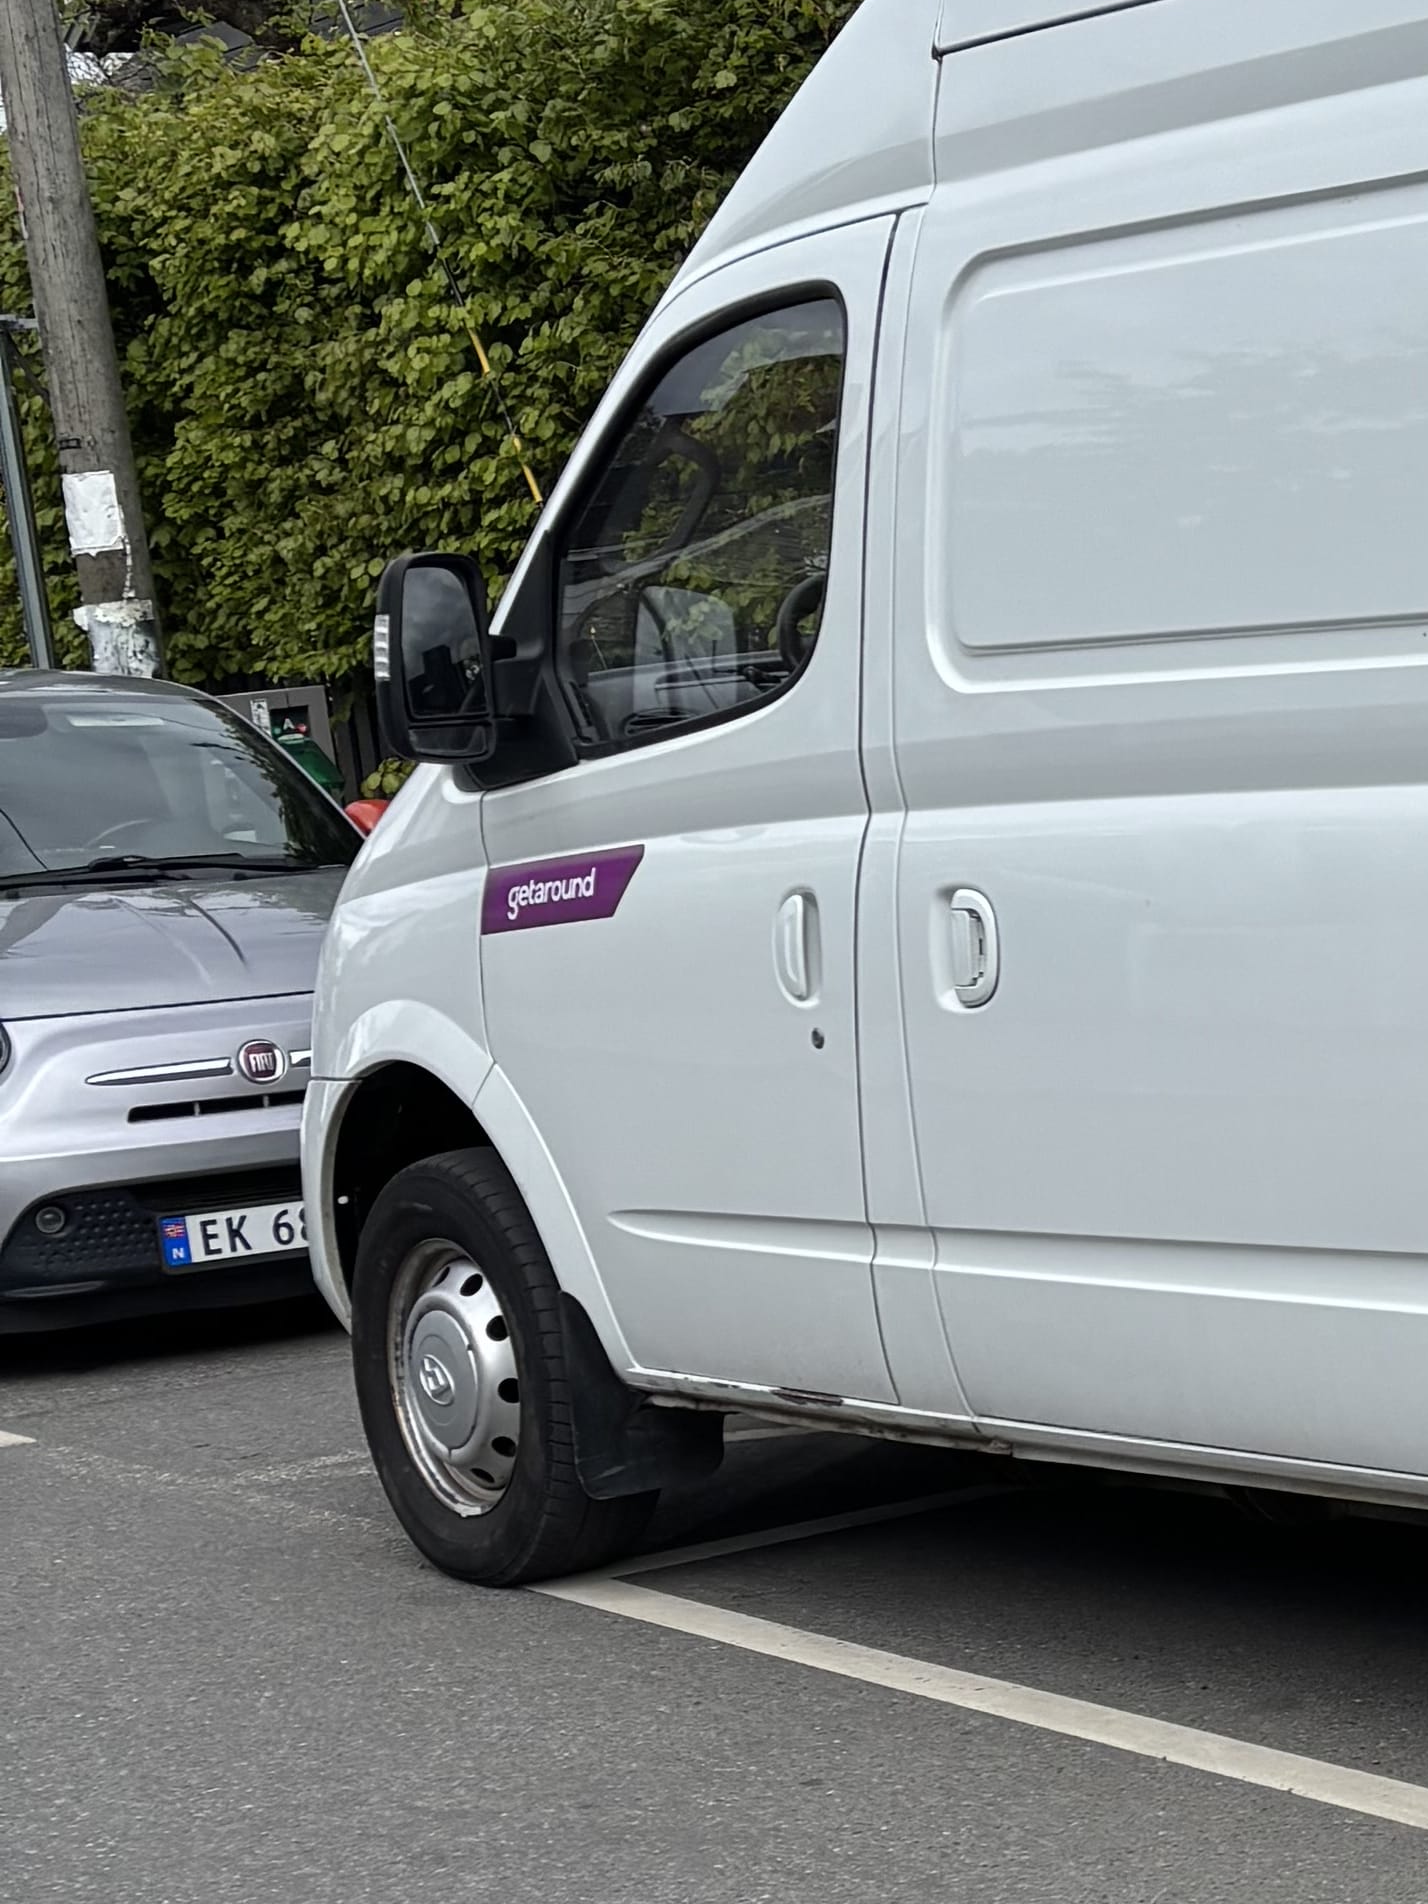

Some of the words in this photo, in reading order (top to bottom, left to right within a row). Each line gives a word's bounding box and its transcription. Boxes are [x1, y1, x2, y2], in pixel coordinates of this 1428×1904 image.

[506, 866, 597, 921] getaround
[171, 1247, 186, 1259] N
[199, 1214, 253, 1257] EK
